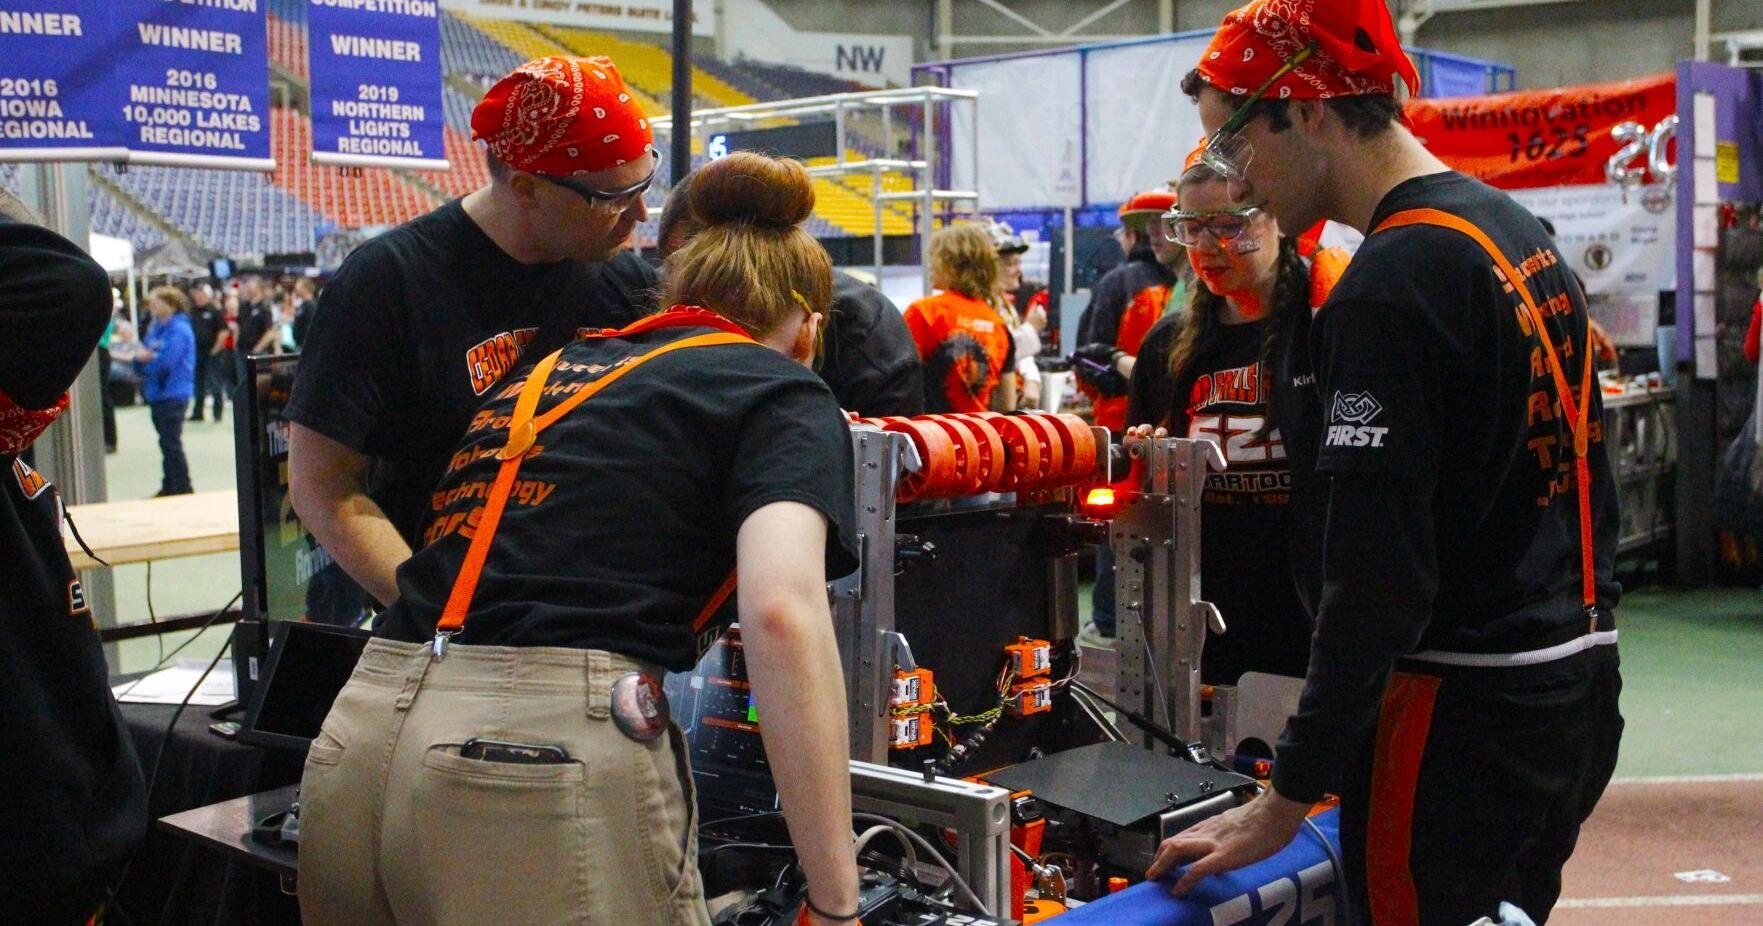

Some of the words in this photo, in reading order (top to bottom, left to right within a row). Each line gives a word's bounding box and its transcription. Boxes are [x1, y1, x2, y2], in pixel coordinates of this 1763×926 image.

[138, 22, 243, 54] WINNER
[330, 33, 421, 62] WINNER
[836, 44, 885, 73] NW
[1, 78, 58, 97] 2016
[166, 68, 218, 90] 2016
[130, 84, 252, 112] MINNESOTA
[358, 84, 399, 102] 2019
[1, 99, 63, 118] IOWA
[122, 104, 191, 127] 10,000
[196, 110, 261, 132] LAKES
[332, 99, 425, 121] NORTHERN
[1441, 93, 1648, 130] Winnovation
[140, 126, 246, 150] REGIONAL
[349, 119, 411, 138] LIGHTS
[338, 136, 423, 157] REGIONAL
[1507, 124, 1590, 163] 1625
